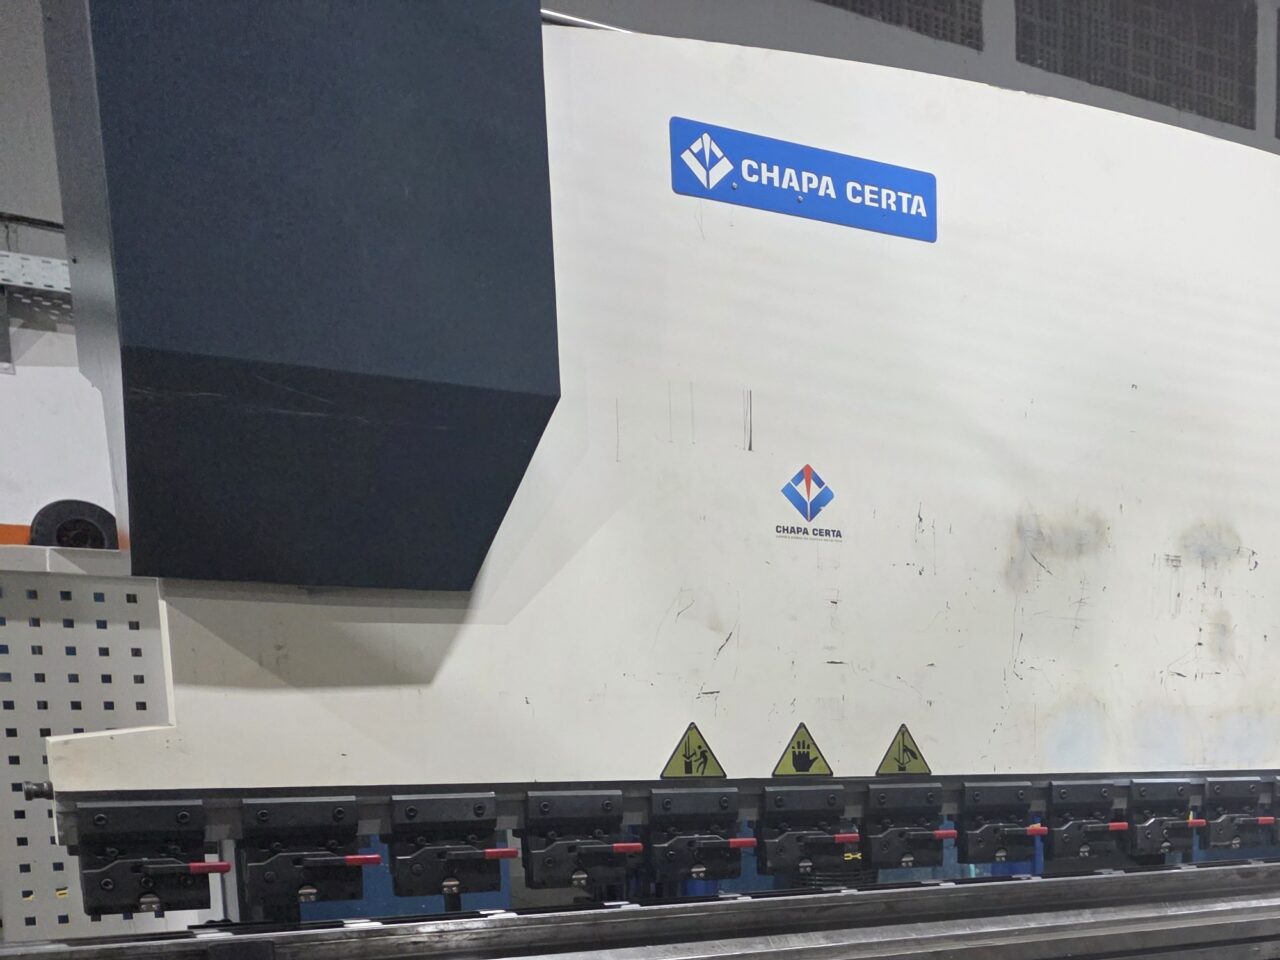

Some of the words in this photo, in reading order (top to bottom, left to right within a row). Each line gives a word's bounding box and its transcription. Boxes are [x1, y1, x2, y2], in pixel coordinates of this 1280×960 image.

[741, 159, 837, 199] CHAPA
[846, 181, 927, 217] CERTA
[775, 525, 809, 535] CHAPA
[812, 528, 842, 538] CERTA
